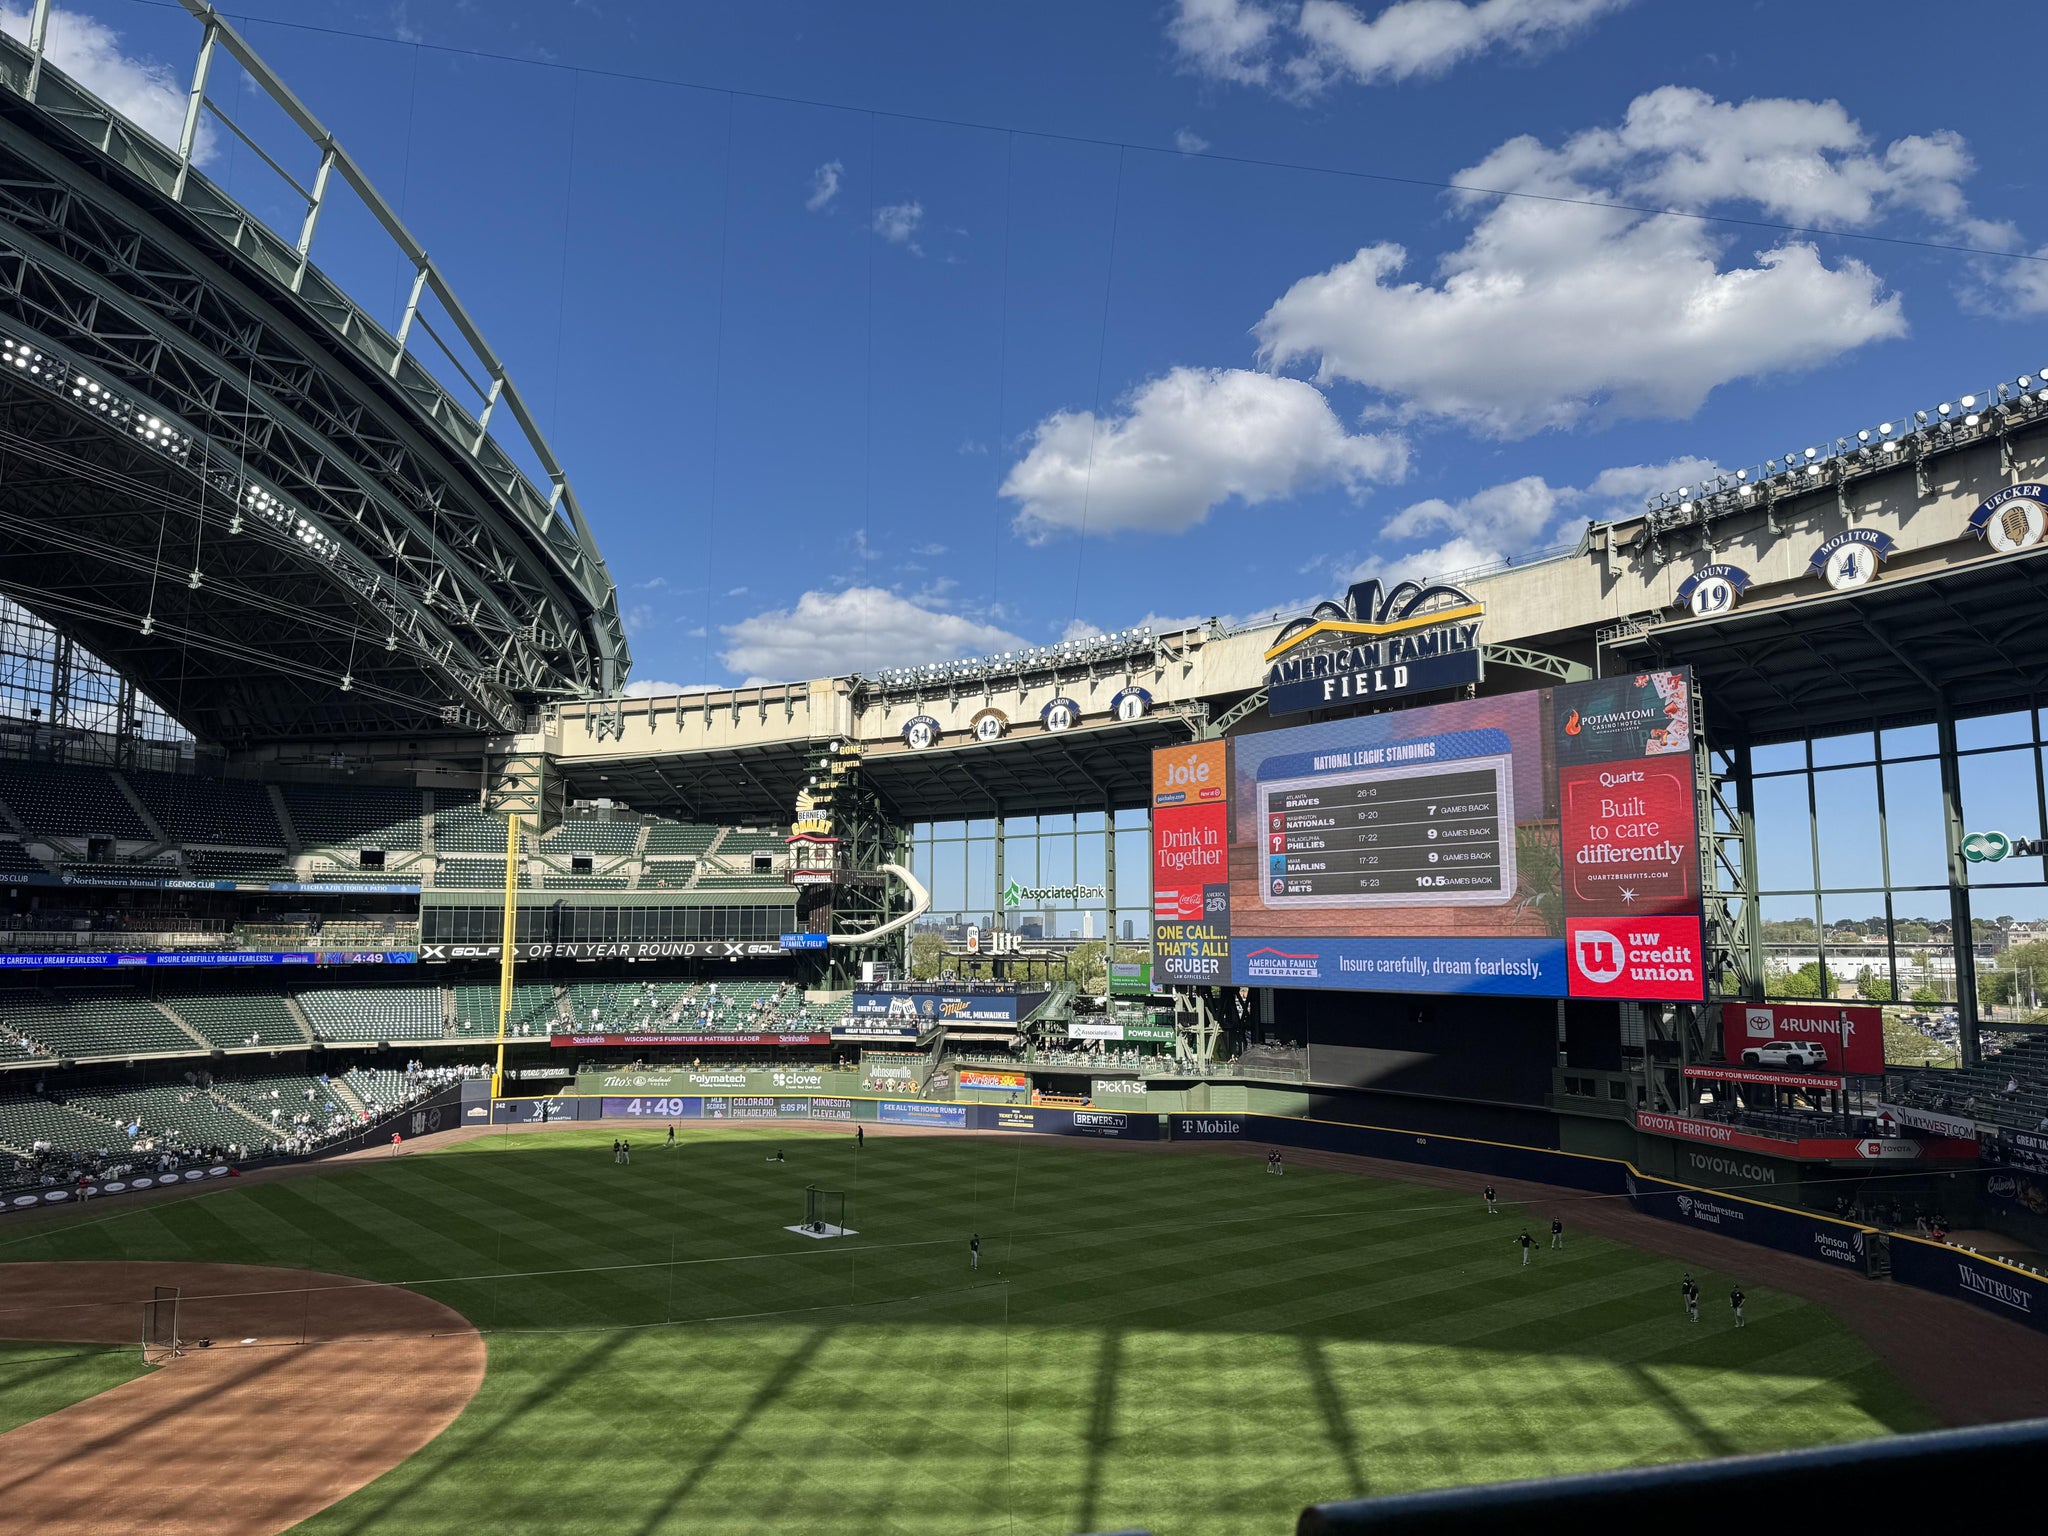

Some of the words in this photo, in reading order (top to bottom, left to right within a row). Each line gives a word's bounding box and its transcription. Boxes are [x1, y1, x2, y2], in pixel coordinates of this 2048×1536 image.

[1984, 485, 2041, 511] UECKER
[1820, 528, 1879, 556] MOLITOR
[1692, 564, 1731, 583] YOUNT
[1840, 553, 1859, 581] 4
[1697, 585, 1727, 614] 19
[1269, 642, 1382, 685] AMERICAN
[1389, 621, 1483, 662] FAMILY
[1323, 666, 1408, 700] FIELD
[1121, 687, 1140, 697] SELIG
[1049, 698, 1069, 708] AARON
[1127, 702, 1135, 718] 1
[908, 715, 933, 727] FINGERS
[1050, 710, 1067, 728] 44
[1581, 708, 1655, 726] POTAWATOMI
[912, 727, 929, 744] 34
[980, 720, 996, 737] 42
[1314, 754, 1353, 771] NATIONAL
[1354, 748, 1384, 766] LEAGUE
[1386, 742, 1436, 762] STANDINGS
[1165, 754, 1210, 786] Joie
[1599, 771, 1645, 788] Quartz
[1286, 798, 1320, 808] BRAVES
[1427, 806, 1437, 816] 7
[1441, 806, 1468, 814] GAMES
[1469, 803, 1490, 813] BACK
[1600, 797, 1646, 819] Built
[798, 809, 826, 820] BERNIE'S
[1358, 811, 1378, 820] 19-20
[791, 819, 832, 835] CHALET
[1286, 818, 1335, 829] NATIONALS
[1590, 823, 1609, 840] to
[1615, 821, 1659, 839] care
[1162, 827, 1201, 848] Drink
[1204, 826, 1217, 845] in
[1359, 834, 1378, 842] 17-22
[1427, 829, 1438, 839] 9
[1441, 830, 1468, 838] GAMES
[1469, 828, 1490, 837] BACK
[1287, 841, 1325, 850] PHILLIES
[1576, 840, 1684, 865] differently
[1159, 846, 1222, 871] Together
[1359, 856, 1379, 865] 17-22
[1428, 853, 1438, 863] 9
[1443, 853, 1470, 862] GAMES
[1470, 852, 1492, 861] BACK
[1288, 863, 1326, 872] MARLINS
[72, 877, 128, 887] Northwestern
[129, 878, 157, 887] Mutual
[1360, 879, 1380, 887] 15-23
[1416, 876, 1445, 887] 10.5
[1444, 877, 1470, 886] GAMES
[1471, 876, 1493, 885] BACK
[1588, 872, 1668, 881] QUARTZBENEFITS.COM
[165, 880, 196, 888] LEGENDS
[1288, 884, 1313, 893] METS
[1206, 897, 1227, 912] 250
[1157, 925, 1184, 939] ONE
[1186, 925, 1227, 940] CALL...
[1628, 932, 1659, 946] uw
[421, 945, 446, 958] X
[451, 947, 501, 956] GOLF
[529, 944, 579, 957] OPEN
[586, 944, 629, 956] YEAR
[643, 943, 696, 956] ROUND
[723, 943, 744, 956] X
[1156, 942, 1198, 956] THAT'S
[1201, 942, 1229, 956] ALL!
[1629, 947, 1692, 963] credit
[44, 956, 65, 964] DREAM
[67, 955, 108, 964] FEARLESSLY.
[217, 955, 237, 963] DREAM
[238, 954, 274, 963] FEARLESSLY.
[353, 953, 384, 963] 4:49
[1248, 958, 1287, 968] AMERICAN
[1289, 959, 1318, 969] FAMILY
[1165, 957, 1219, 974] GRUBER
[1339, 955, 1374, 973] Insure
[1376, 956, 1430, 977] carefully,
[1432, 957, 1472, 975] dream
[1474, 957, 1542, 980] fearlessly.
[1253, 969, 1313, 977] INSURANCE
[1630, 964, 1694, 982] union
[939, 1001, 971, 1017] Miller
[973, 1011, 1010, 1019] MILWAUKEE
[689, 1073, 746, 1084] Polymatech
[786, 1073, 822, 1084] clover
[869, 1065, 912, 1079] Johnsonville
[967, 1072, 999, 1086] Surfside
[1684, 1068, 1715, 1077] COURTESY
[1725, 1071, 1742, 1079] YOUR
[1742, 1073, 1780, 1082] WISCONSIN
[1781, 1076, 1807, 1084] TOYOTA
[1807, 1078, 1838, 1087] DEALERS
[627, 1098, 683, 1116] 4:49
[733, 1098, 774, 1106] COLORADO
[780, 1103, 795, 1112] 5:05
[796, 1104, 807, 1112] PM
[812, 1098, 851, 1108] MINNESOTA
[884, 1103, 896, 1111] SEE
[896, 1104, 907, 1112] ALL
[939, 1106, 957, 1114] RUNS
[733, 1108, 777, 1117] PHILADELPHIA
[812, 1109, 851, 1119] CLEVELAND
[1076, 1114, 1124, 1126] BREWERS.TV
[1196, 1119, 1240, 1133] Mobile
[1638, 1113, 1675, 1132] TOYOTA
[1677, 1118, 1732, 1142] TERRITORY
[1416, 1137, 1427, 1145] 400
[2016, 1134, 2038, 1148] GREAT
[1688, 1153, 1775, 1184] TOYOTA.COM
[1694, 1200, 1744, 1220] Northwestern
[1694, 1209, 1721, 1224] Mutual
[1814, 1232, 1848, 1250] Johnson
[1820, 1245, 1856, 1263] Controls
[1957, 1263, 2031, 1309] WINTRUST
